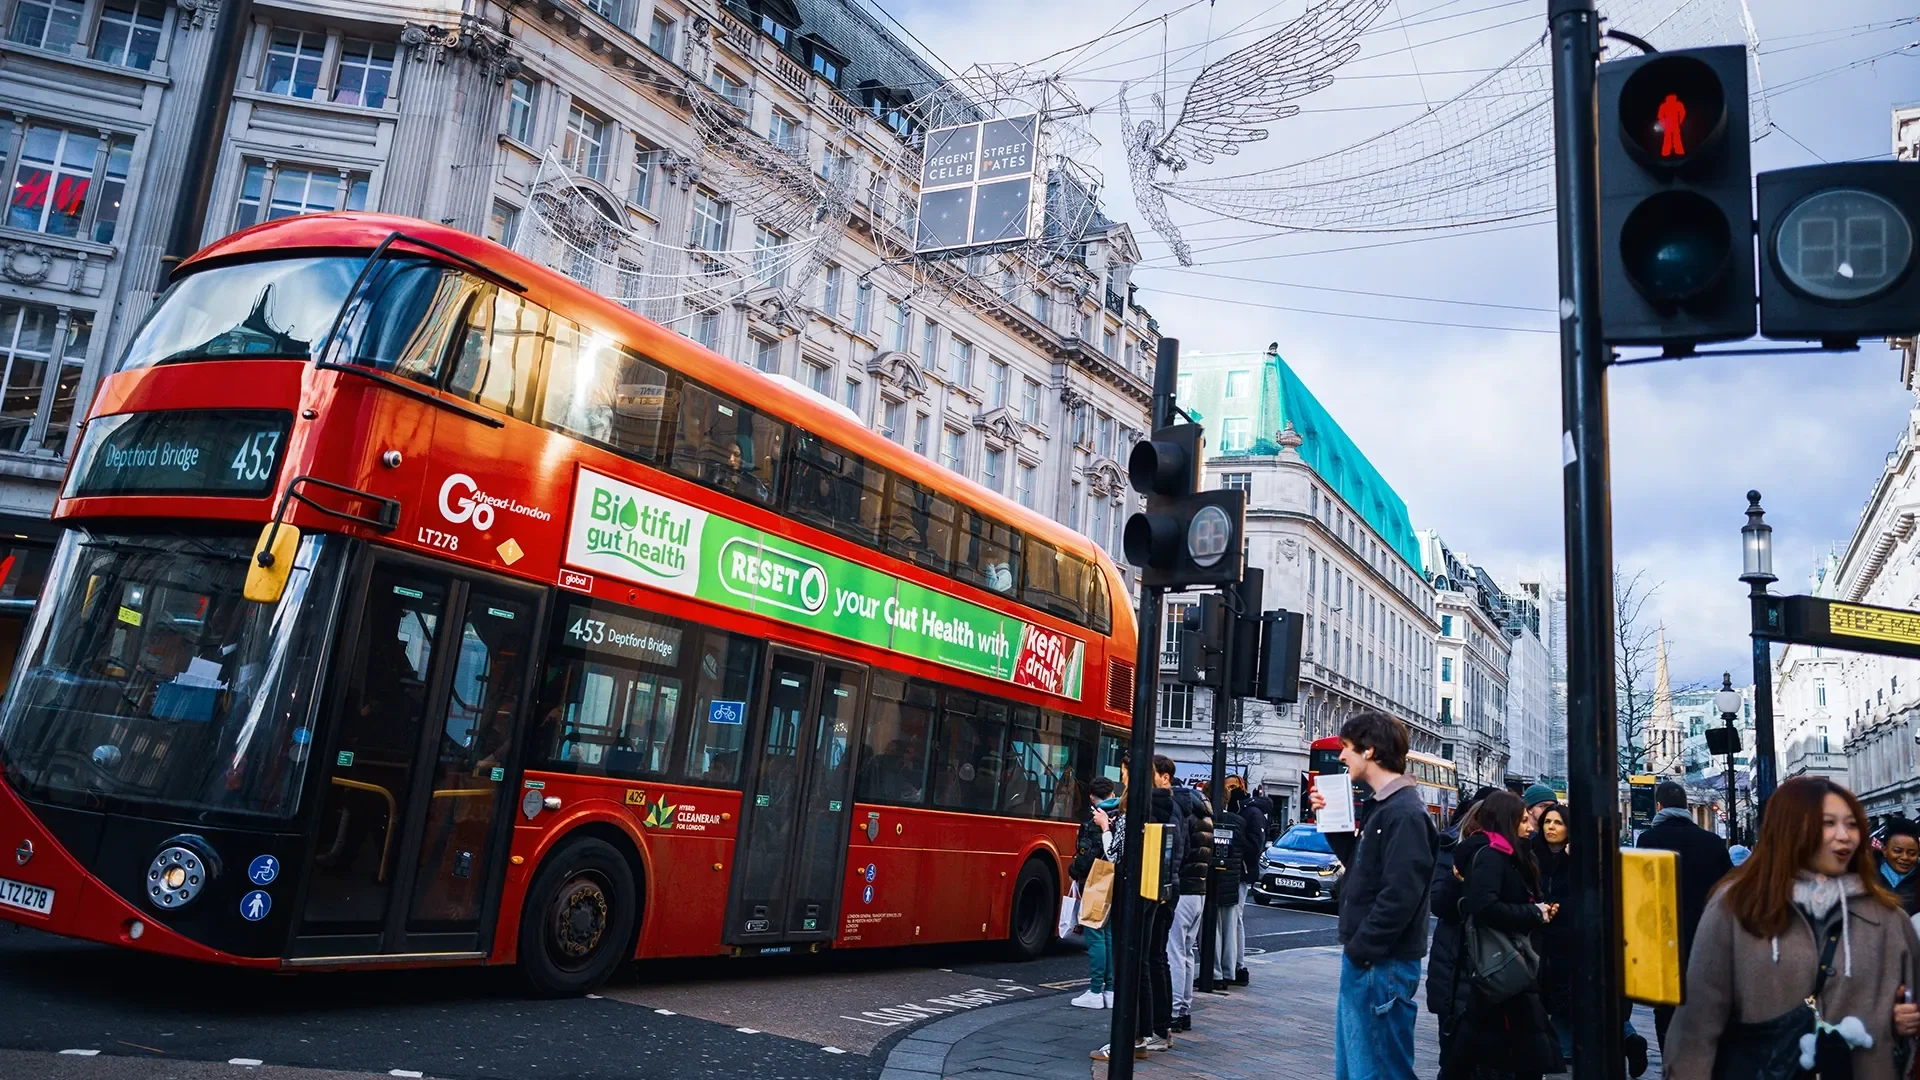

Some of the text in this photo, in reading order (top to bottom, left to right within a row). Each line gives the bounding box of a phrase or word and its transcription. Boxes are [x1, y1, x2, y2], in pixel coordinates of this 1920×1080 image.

[931, 142, 1027, 167] REGENT STREET
[105, 431, 280, 480] Deptford Bridge 453
[438, 473, 494, 531] Go
[472, 490, 551, 522] Ahead-London
[417, 526, 459, 551] LT278
[587, 526, 685, 571] gut health
[565, 573, 587, 586] global
[731, 550, 1010, 660] RESET your Gut Health with
[569, 618, 673, 657] 453 Deptford Bridge
[1891, 617, 1920, 637] MA
[1026, 624, 1067, 676] kefir
[1025, 653, 1058, 693] drink
[628, 791, 645, 803] 429
[678, 804, 696, 812] HYBRID
[839, 1003, 955, 1026] LOOK
